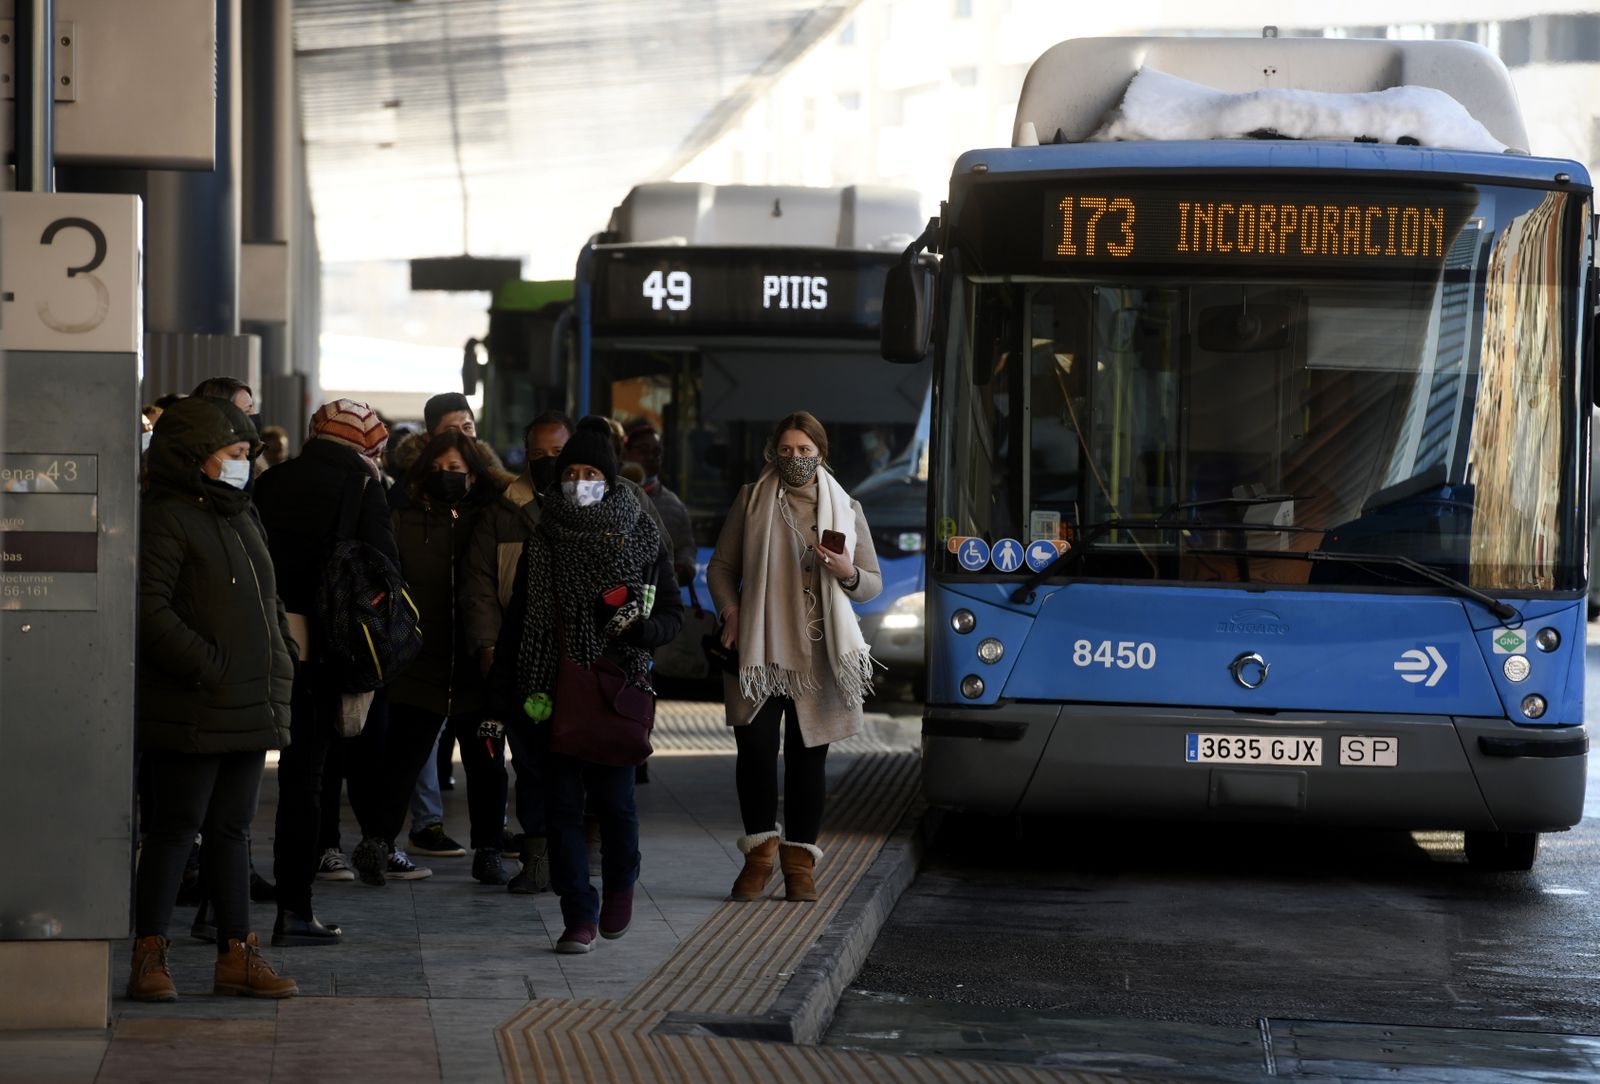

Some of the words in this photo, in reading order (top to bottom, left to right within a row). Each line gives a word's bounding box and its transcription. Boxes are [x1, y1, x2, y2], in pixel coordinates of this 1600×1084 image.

[1056, 196, 1136, 257] 173
[1176, 203, 1444, 257] INCORPORACION
[643, 270, 692, 311] 49
[763, 275, 828, 310] PITIS
[46, 460, 78, 482] 43
[1059, 543, 1067, 553] 2
[1500, 637, 1520, 646] GNC
[1072, 639, 1157, 670] 8450
[1202, 737, 1262, 760] 3635
[1271, 739, 1316, 762] GJX
[1347, 740, 1390, 762] SP
